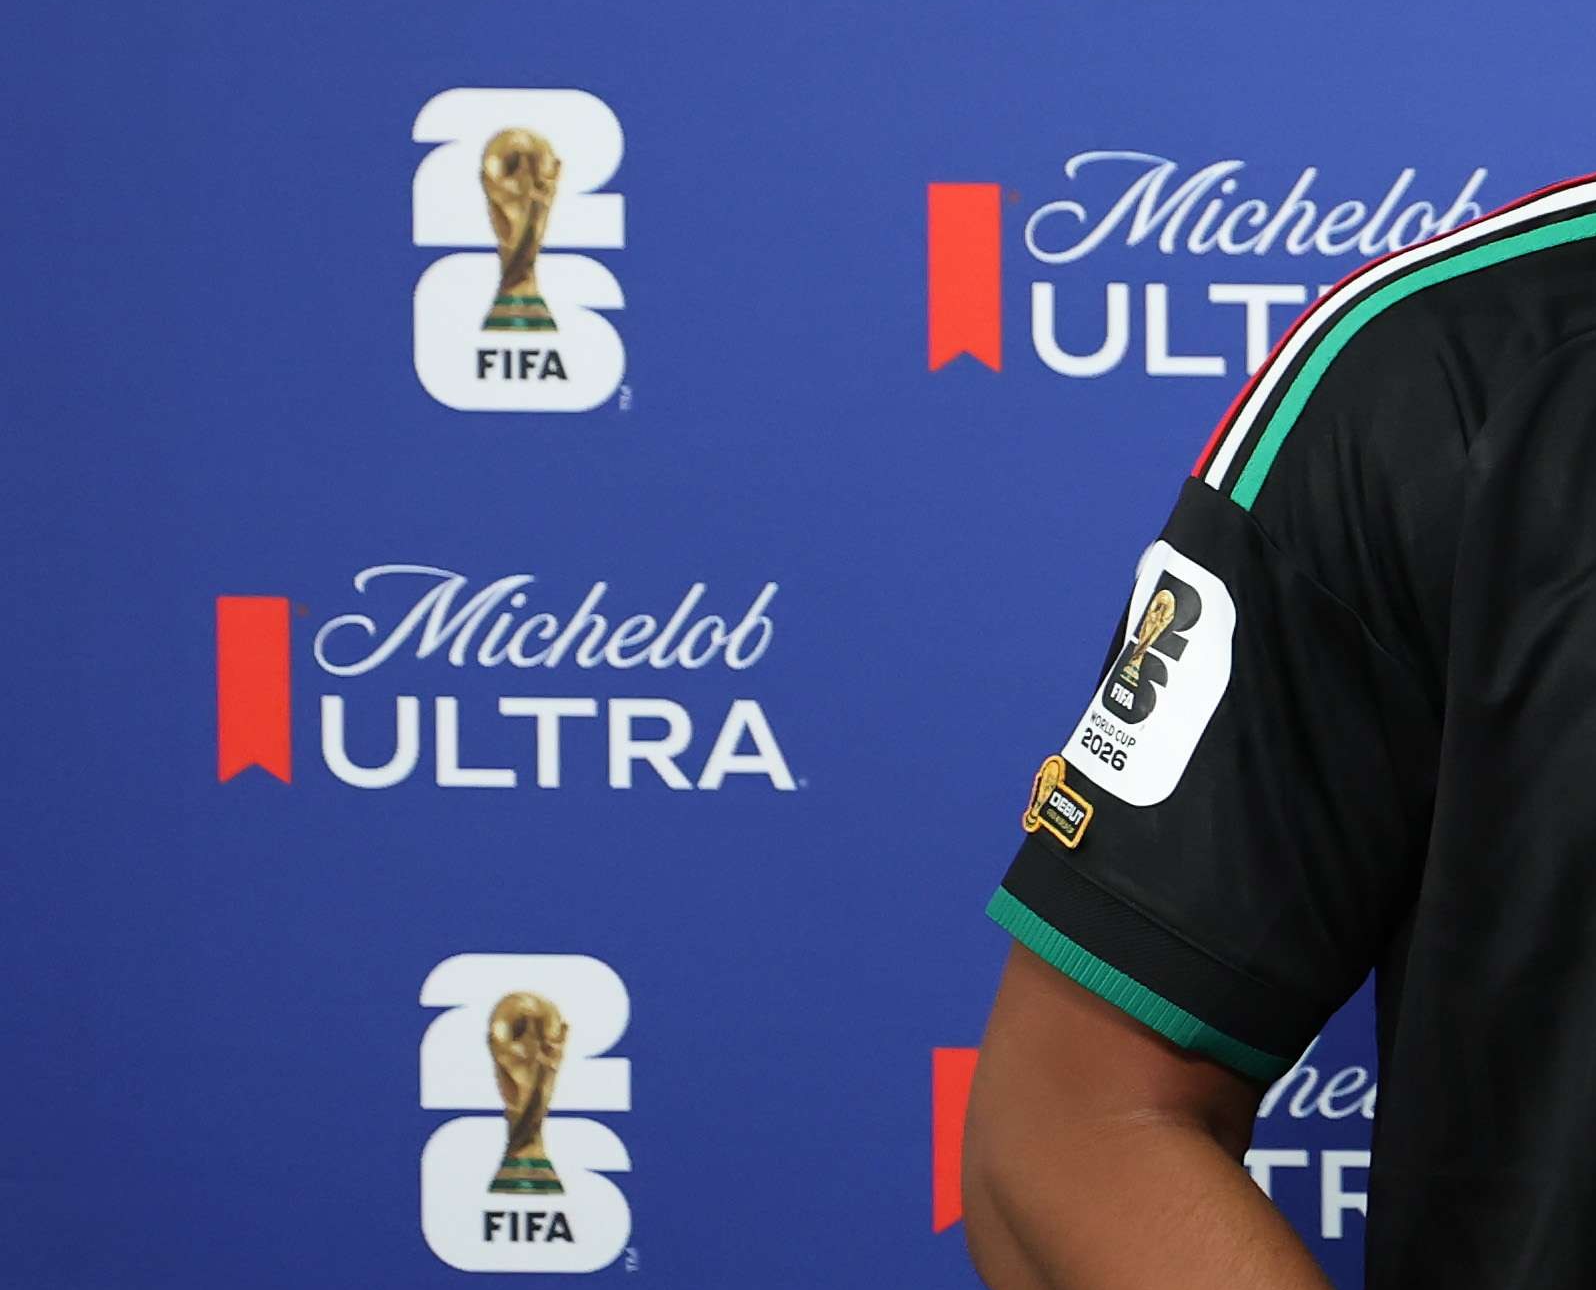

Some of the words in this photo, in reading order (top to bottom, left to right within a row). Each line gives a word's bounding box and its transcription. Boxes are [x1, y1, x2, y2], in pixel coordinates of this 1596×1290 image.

[1031, 282, 1332, 377] ULT
[476, 348, 568, 381] FIFA
[314, 565, 777, 675] Michelob
[1110, 682, 1135, 710] FIFA
[321, 695, 795, 790] ULTRA
[1090, 710, 1115, 736] WORLD
[1115, 729, 1136, 748] CUP
[1081, 727, 1128, 771] 2026
[1049, 791, 1085, 825] DEBUT
[483, 1210, 575, 1243] FIFA
